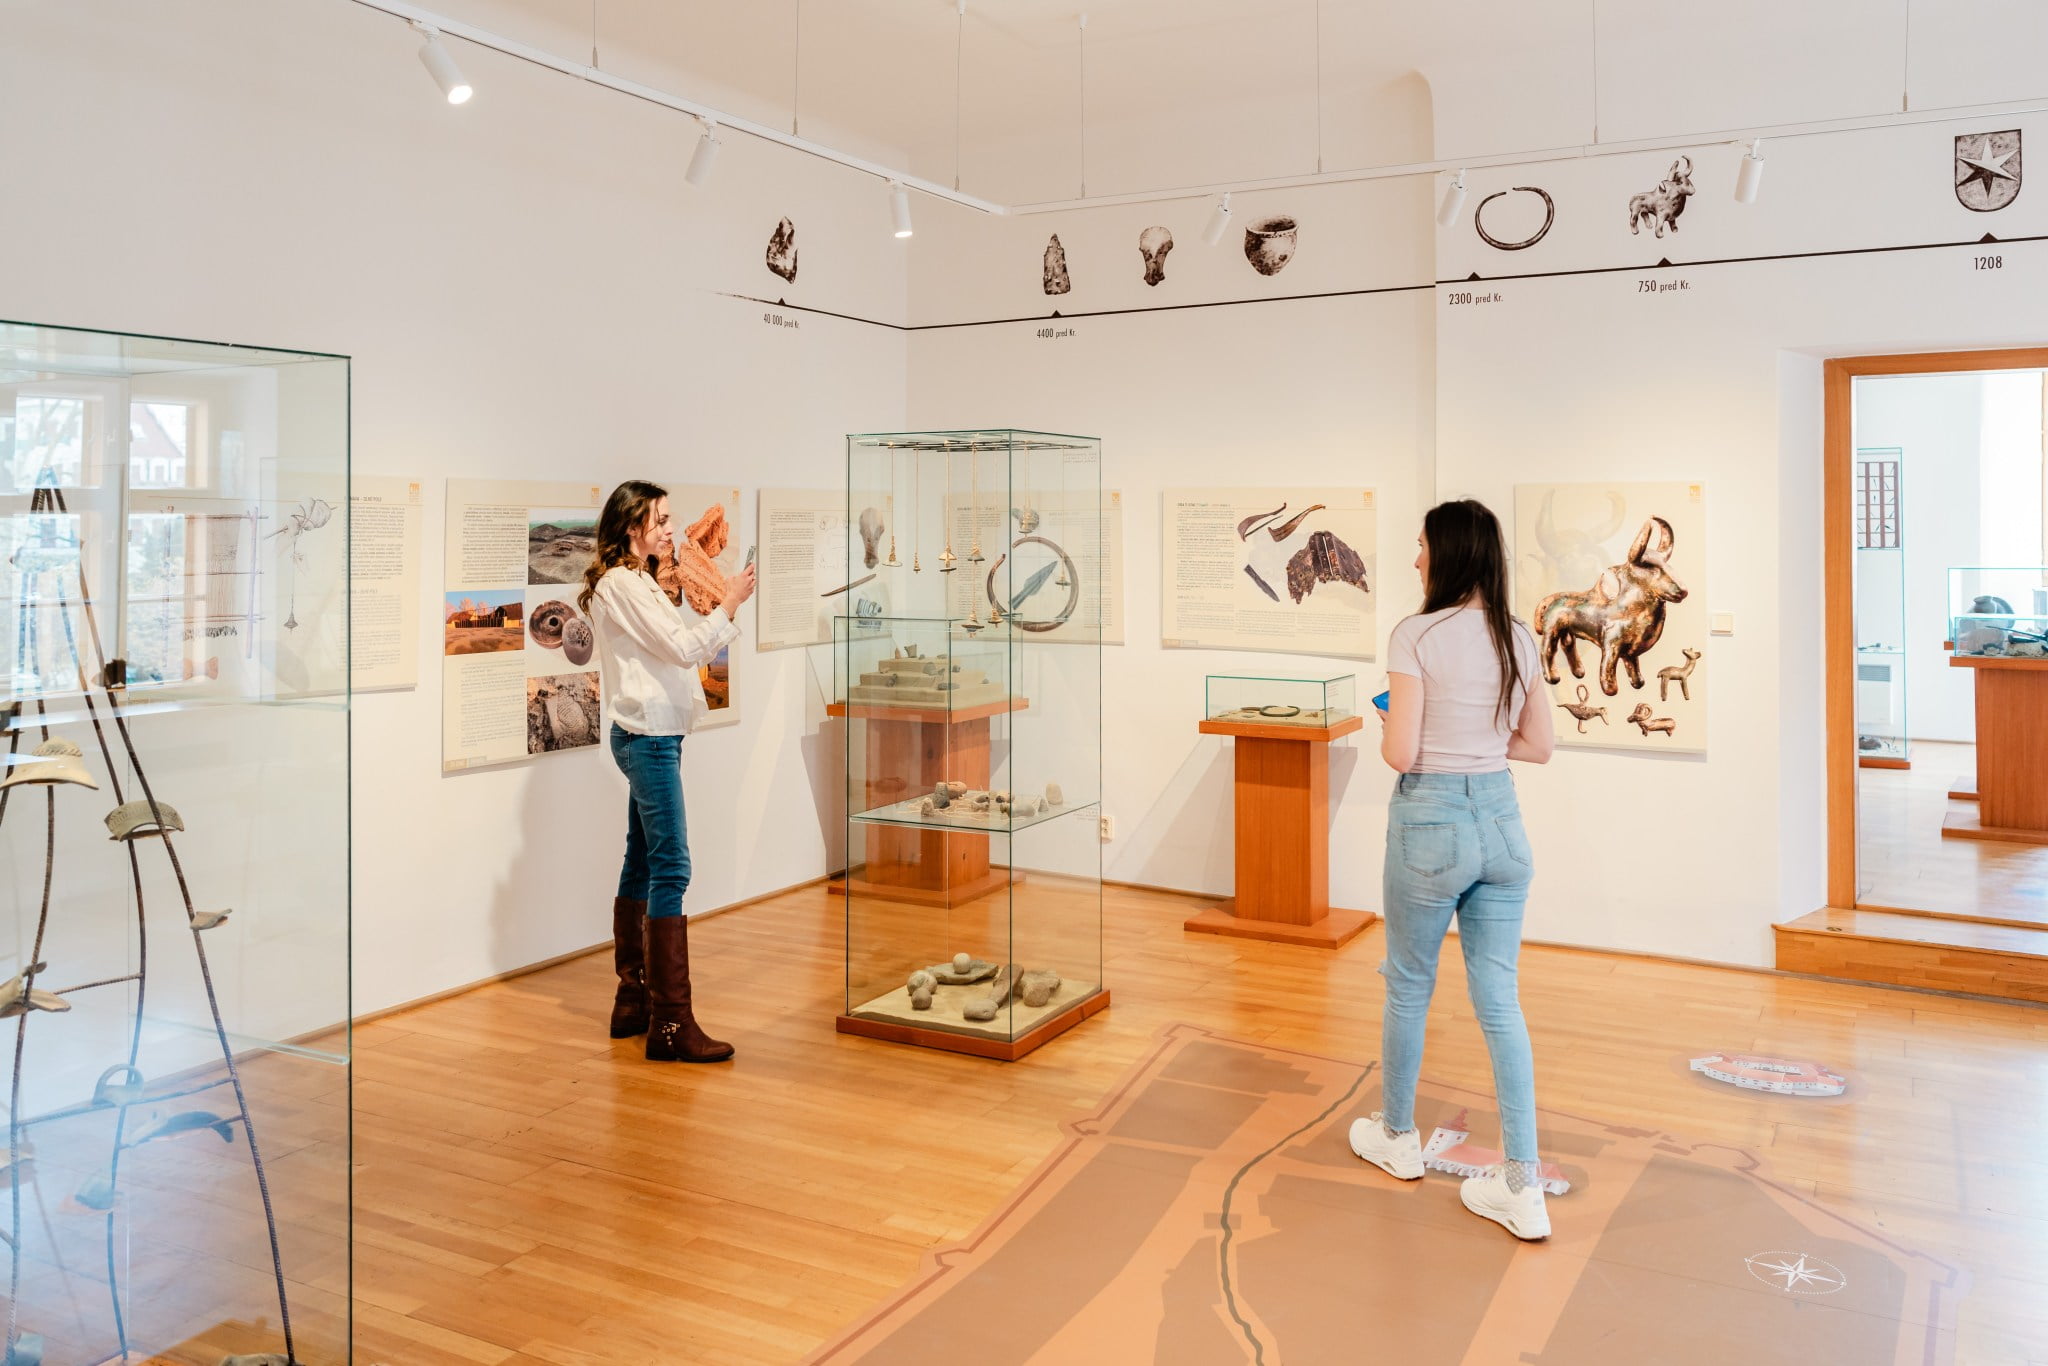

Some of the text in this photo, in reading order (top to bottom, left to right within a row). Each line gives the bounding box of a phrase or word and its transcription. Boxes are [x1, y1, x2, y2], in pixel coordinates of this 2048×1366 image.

[1974, 255, 2002, 271] 1208
[1638, 279, 1691, 294] 750 pred Kr.
[1448, 292, 1504, 306] 2300 pred Kr.
[1036, 327, 1054, 339] 4400
[1055, 327, 1068, 340] pred
